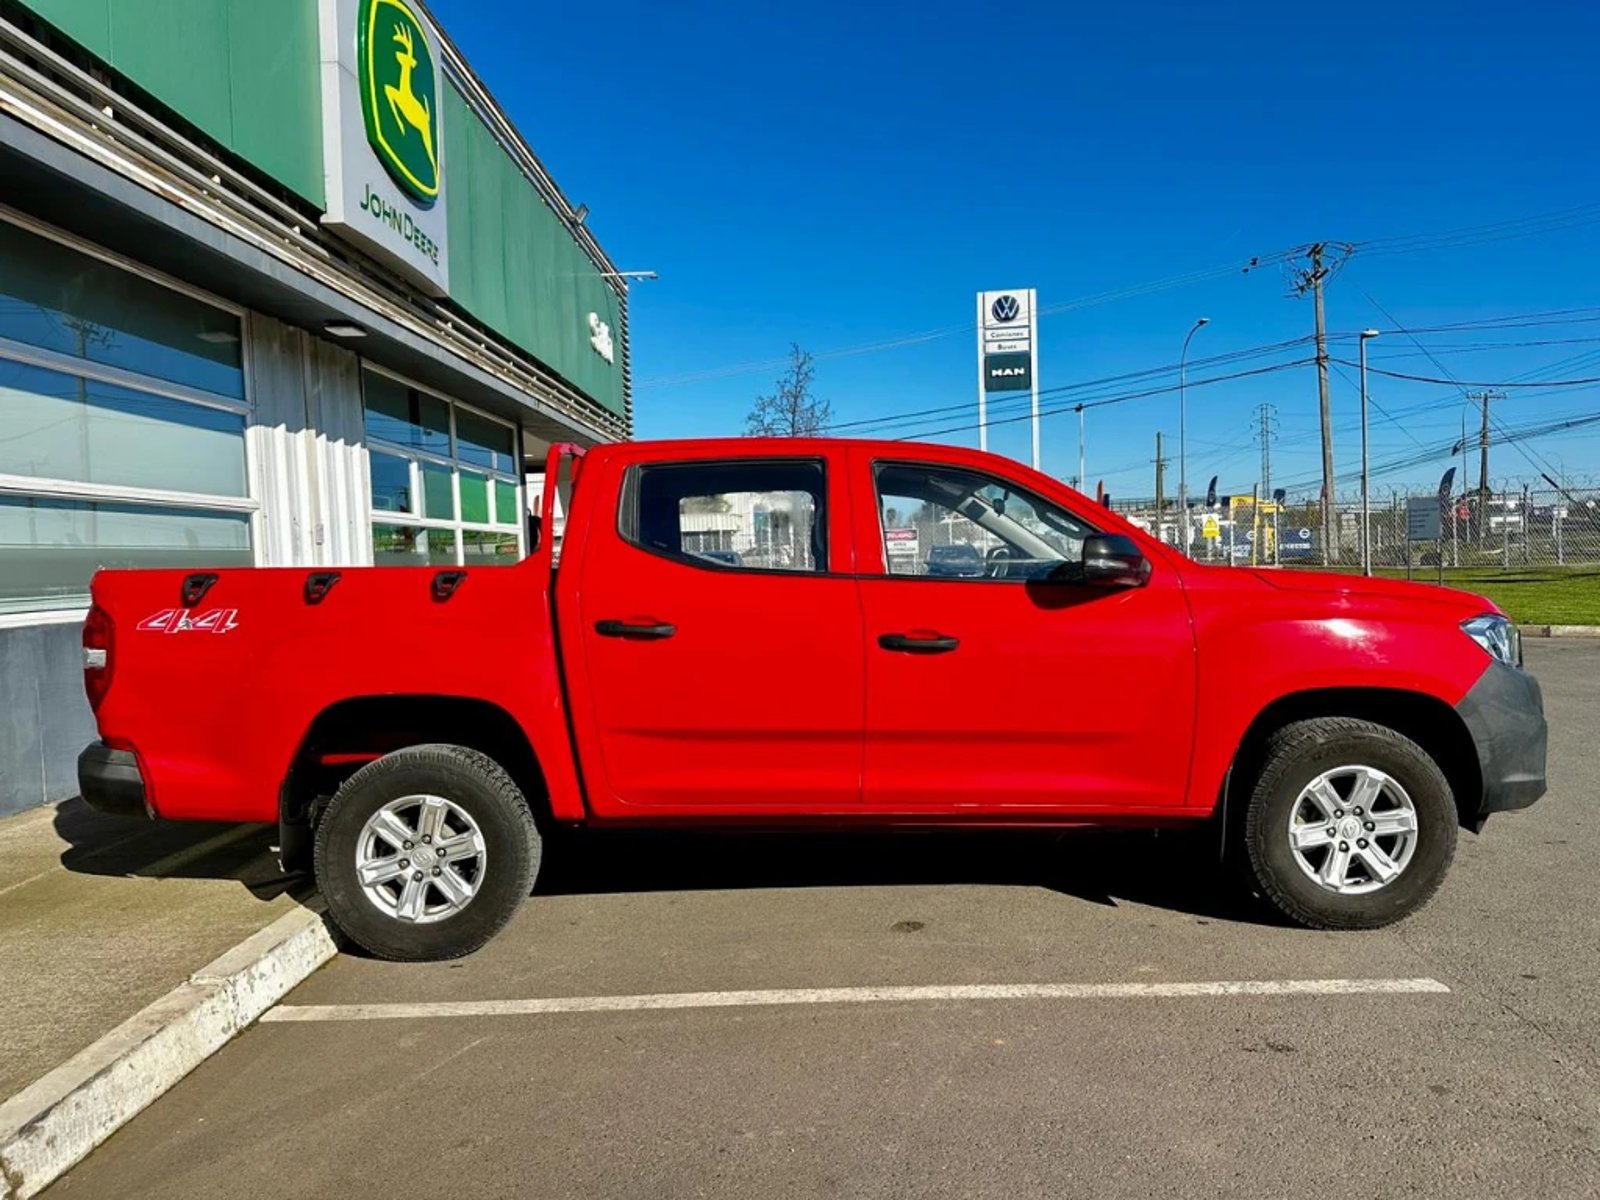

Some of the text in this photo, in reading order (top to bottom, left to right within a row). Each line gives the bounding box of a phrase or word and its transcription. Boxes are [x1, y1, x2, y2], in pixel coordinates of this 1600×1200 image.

[360, 183, 439, 267] JOHN DEERE
[991, 367, 1025, 377] MAN
[136, 608, 239, 634] 4x4
